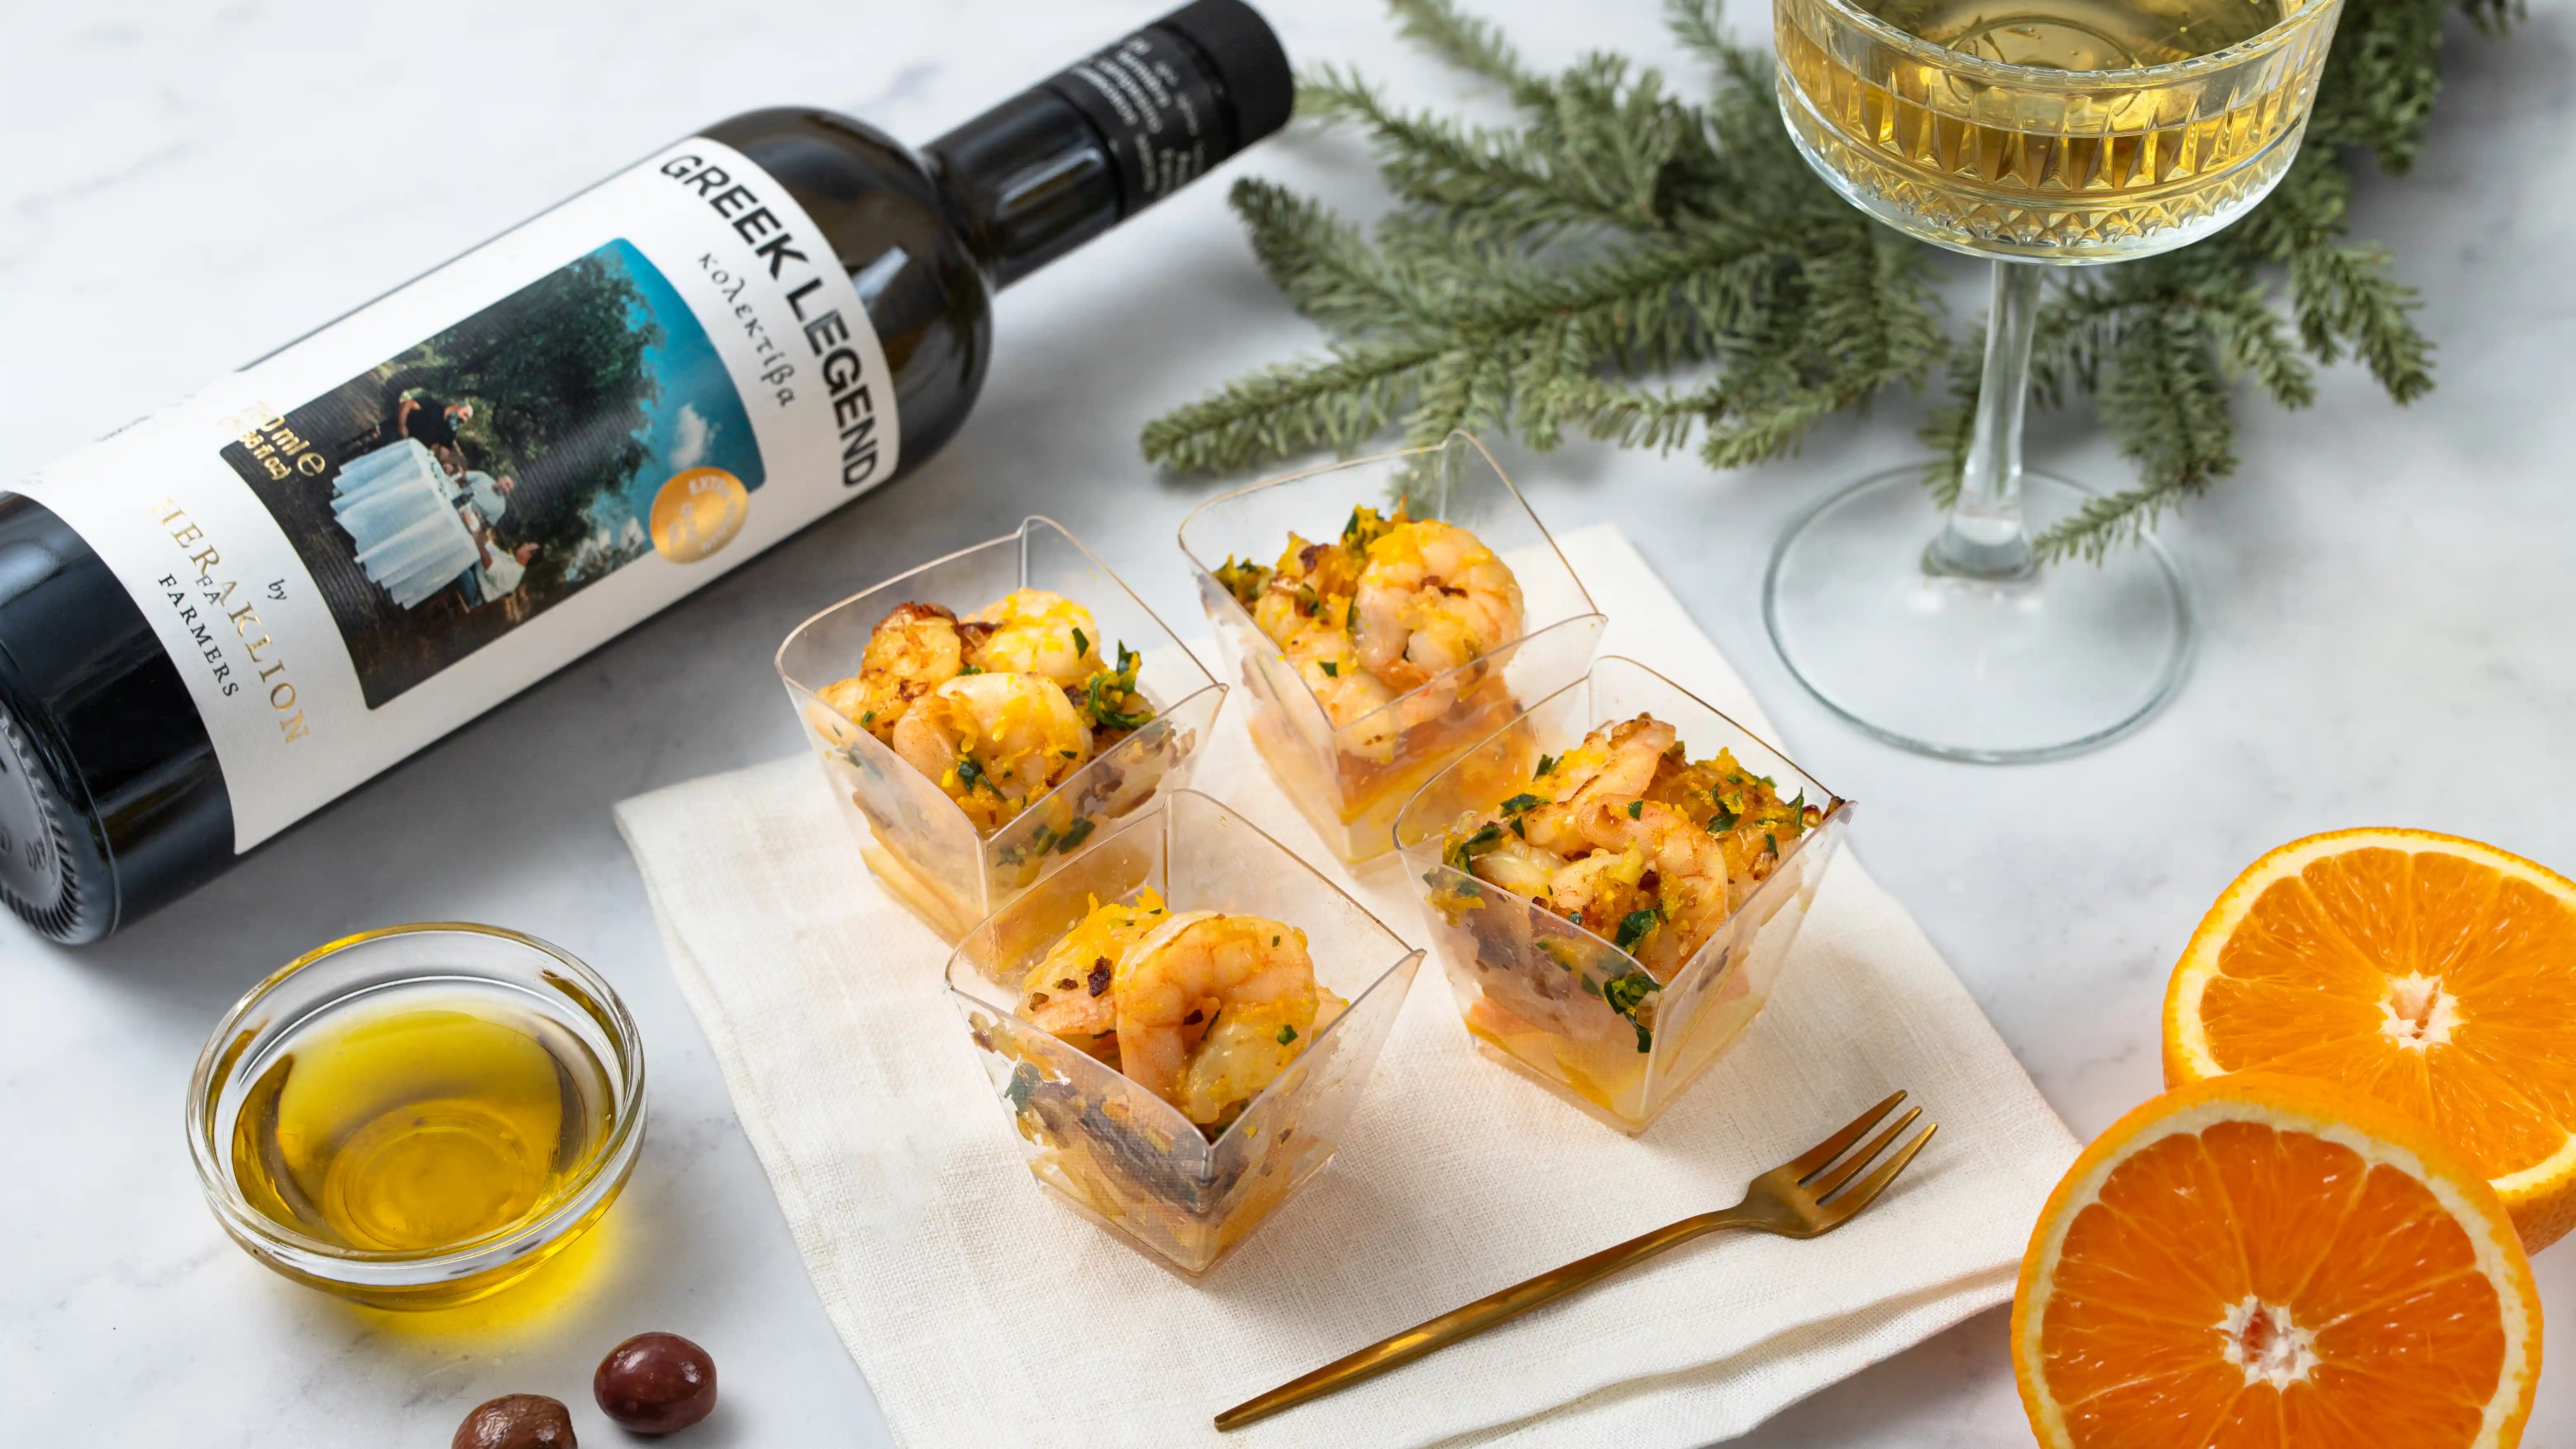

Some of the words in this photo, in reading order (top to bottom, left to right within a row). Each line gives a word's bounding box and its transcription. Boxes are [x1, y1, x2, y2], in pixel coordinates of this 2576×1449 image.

[660, 154, 808, 281] GREEK
[786, 277, 879, 489] LEGEND
[698, 253, 796, 408] κολεκτίβα
[150, 497, 309, 743] HERAKLION
[158, 573, 239, 696] FARMERS
[268, 578, 287, 600] by
